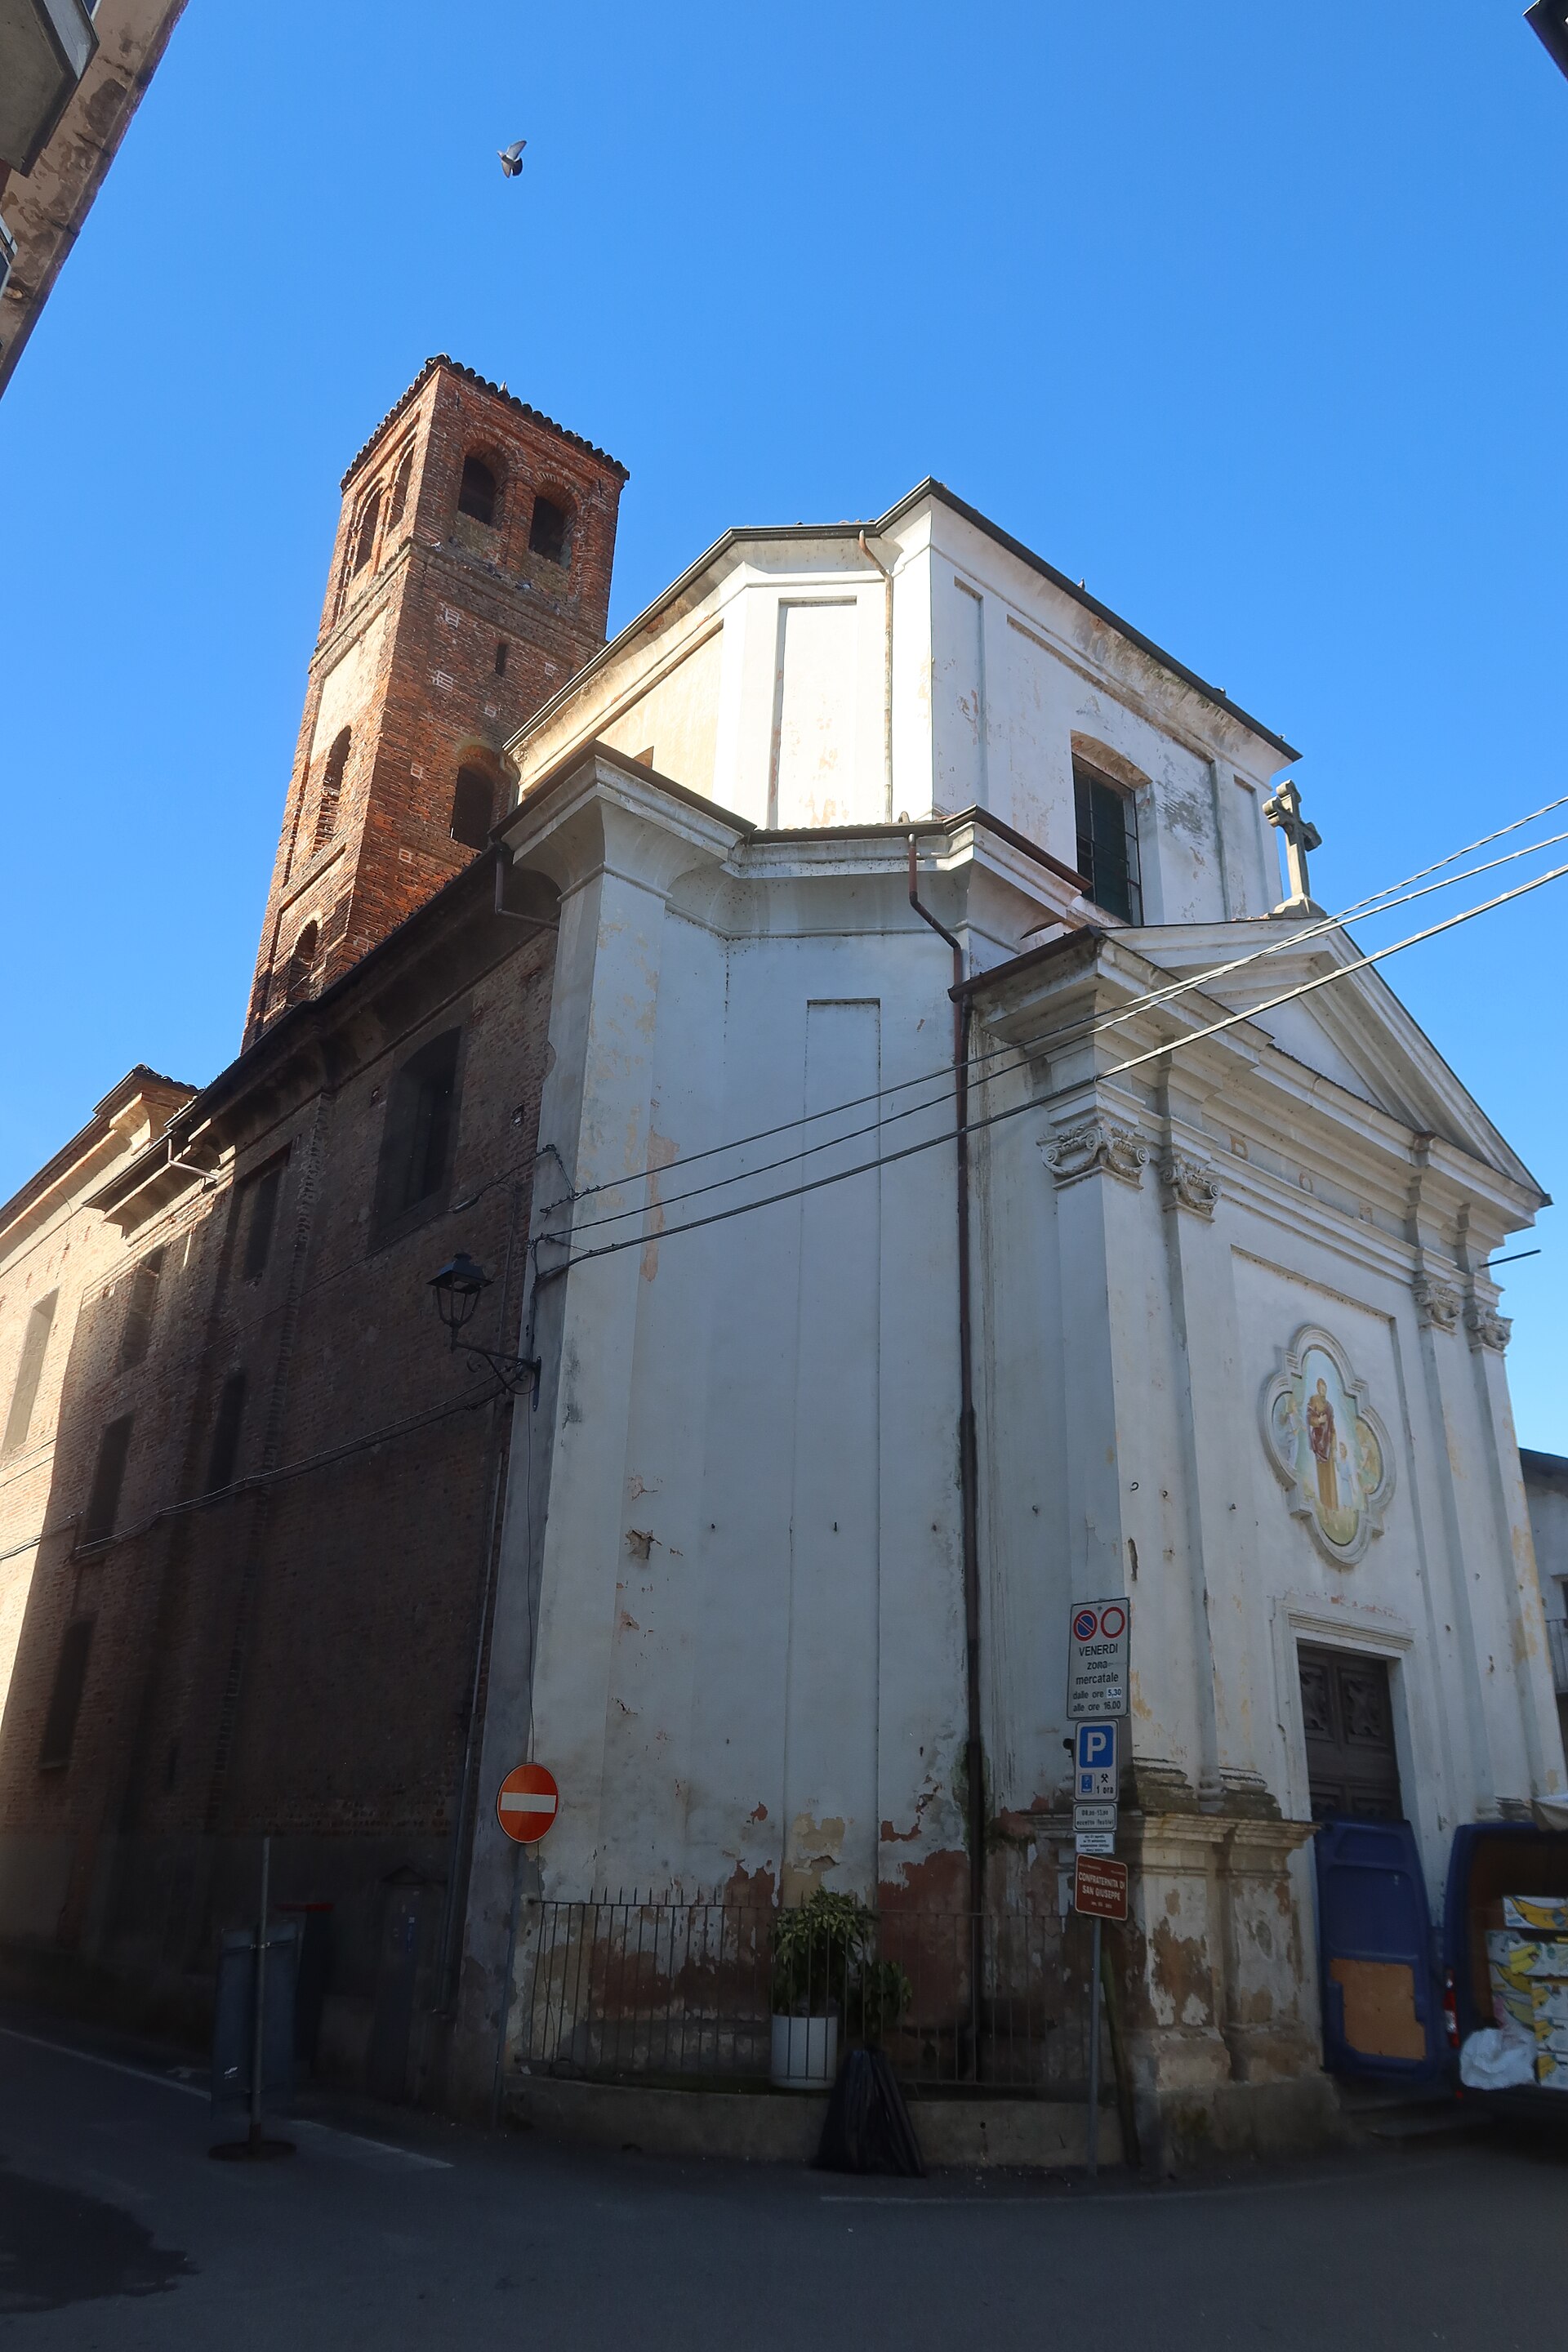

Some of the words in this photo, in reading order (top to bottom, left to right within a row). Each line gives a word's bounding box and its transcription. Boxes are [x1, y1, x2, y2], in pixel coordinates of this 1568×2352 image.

[1087, 1660, 1108, 1670] zona
[1076, 1672, 1119, 1685] mercatale
[1072, 1690, 1089, 1700] dalle
[1092, 1690, 1104, 1699] ore
[1073, 1703, 1085, 1713] alle
[1086, 1731, 1107, 1762] P
[1096, 1785, 1100, 1794] 1
[1082, 1885, 1094, 1895] SAN
[1095, 1887, 1121, 1901] GIUSEPPE
